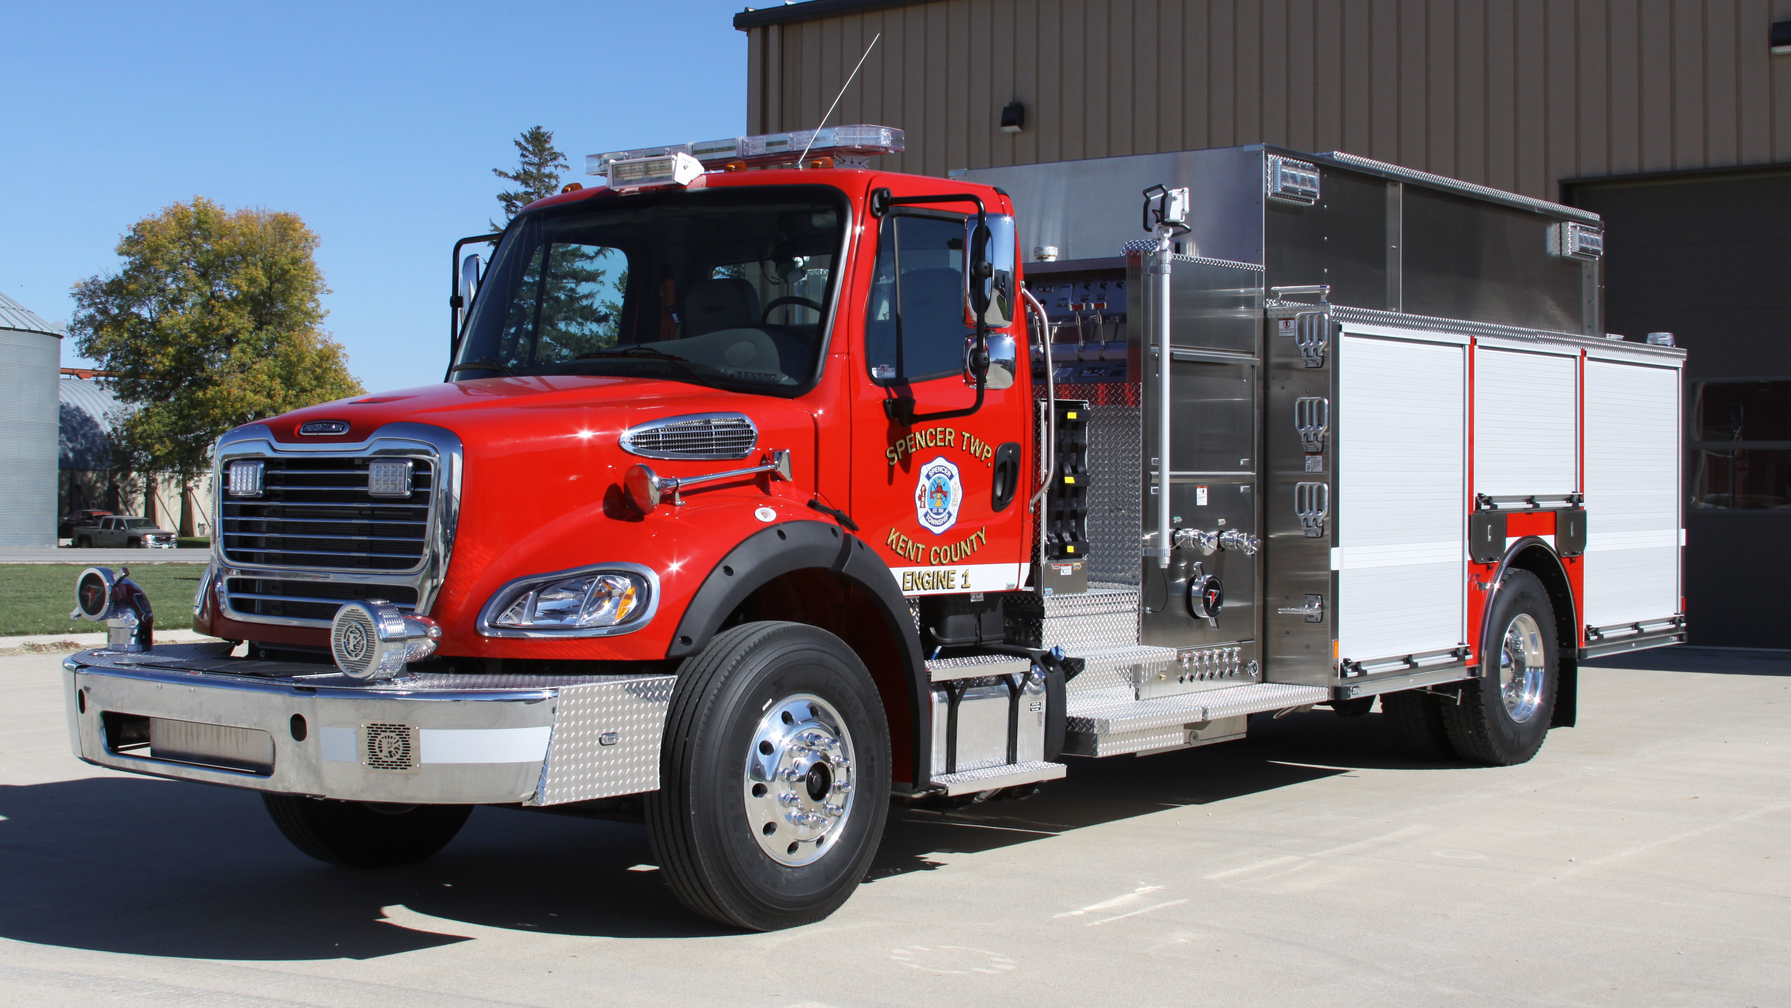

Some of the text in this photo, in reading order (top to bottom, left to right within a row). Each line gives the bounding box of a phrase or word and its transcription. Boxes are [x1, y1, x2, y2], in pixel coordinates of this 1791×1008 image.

[886, 427, 993, 467] SPENCER TWP.
[886, 526, 987, 565] KENT COUNTY
[902, 569, 971, 591] ENGINE 1
